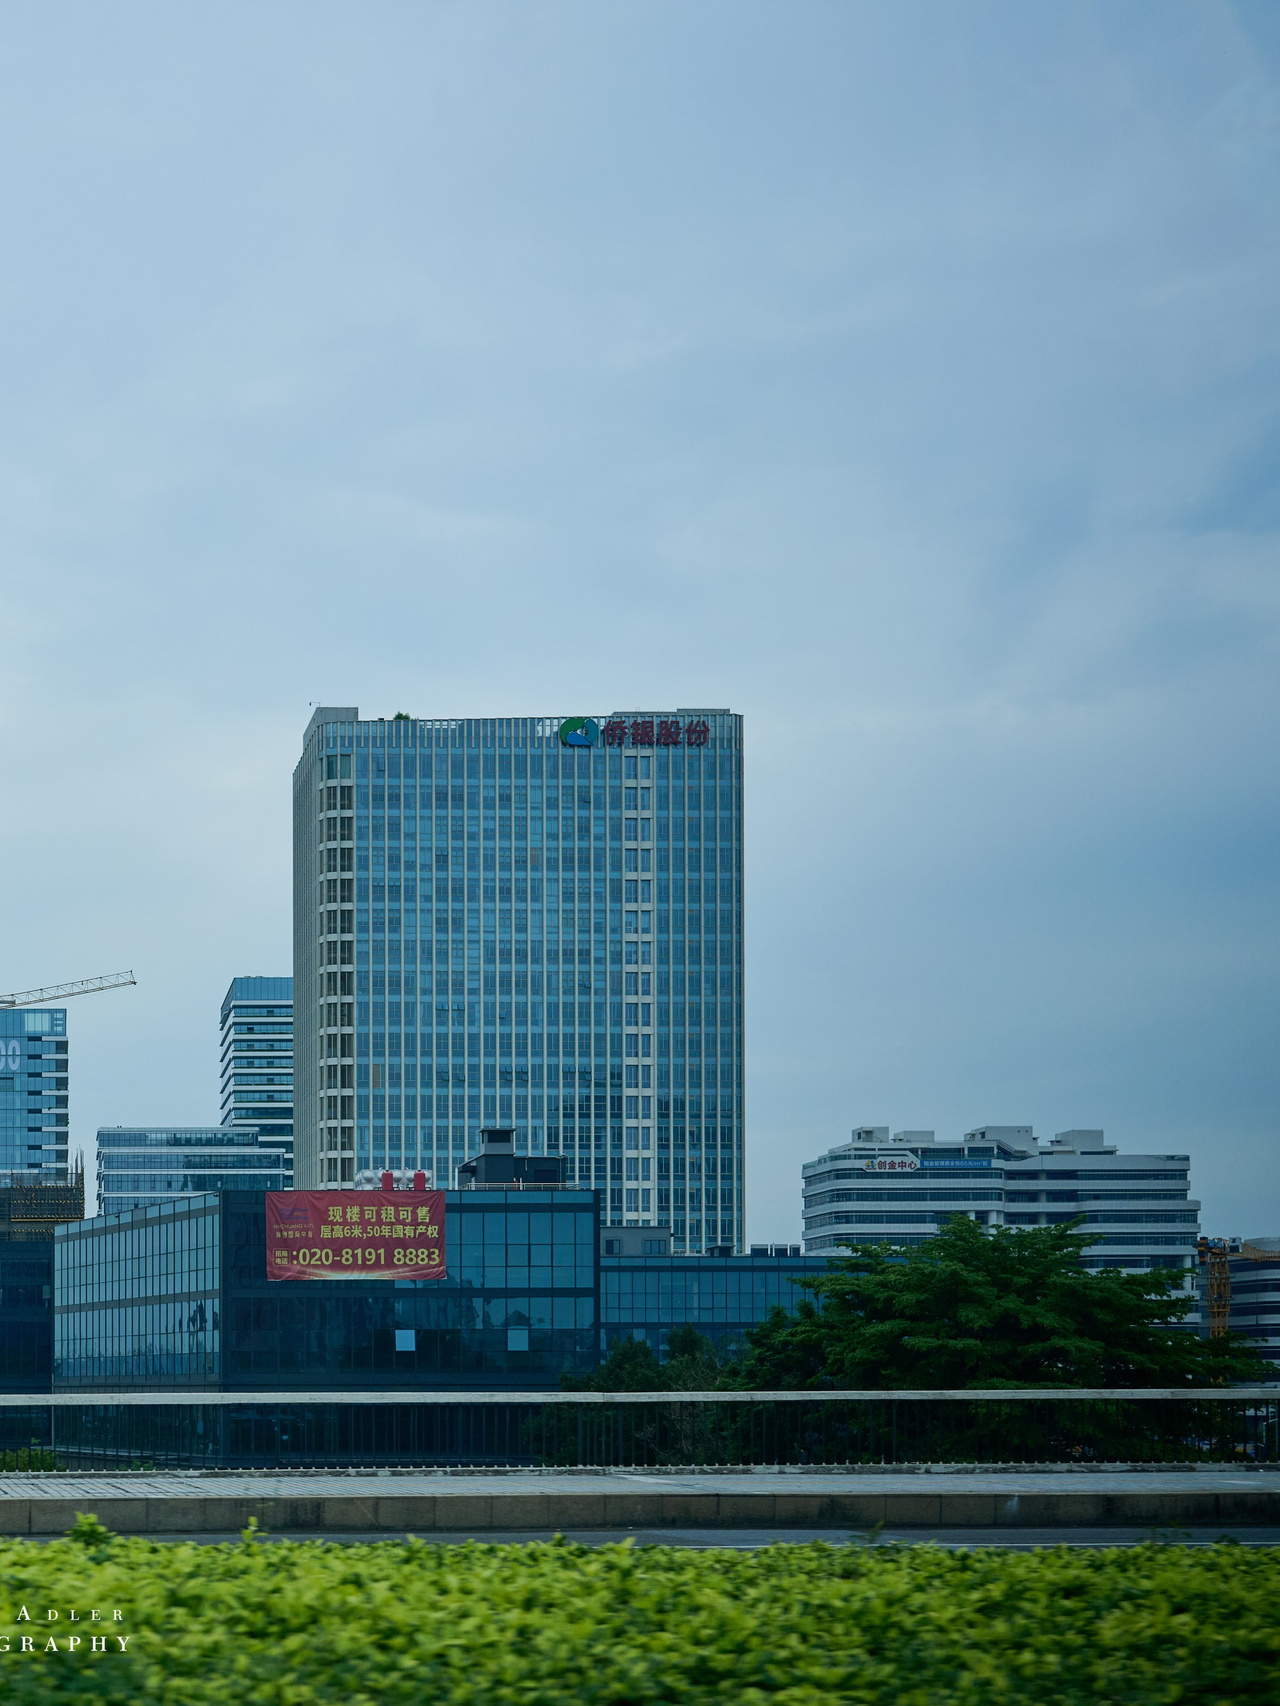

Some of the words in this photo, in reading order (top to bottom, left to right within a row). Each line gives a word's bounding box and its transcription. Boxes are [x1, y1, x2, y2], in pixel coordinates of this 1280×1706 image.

[604, 720, 710, 745] 侨银股份
[877, 1160, 917, 1170] 创金中心
[328, 1206, 430, 1223] 现楼可租可售
[320, 1225, 439, 1240] 层高6米,50年国有产权
[393, 1248, 440, 1265] 8883
